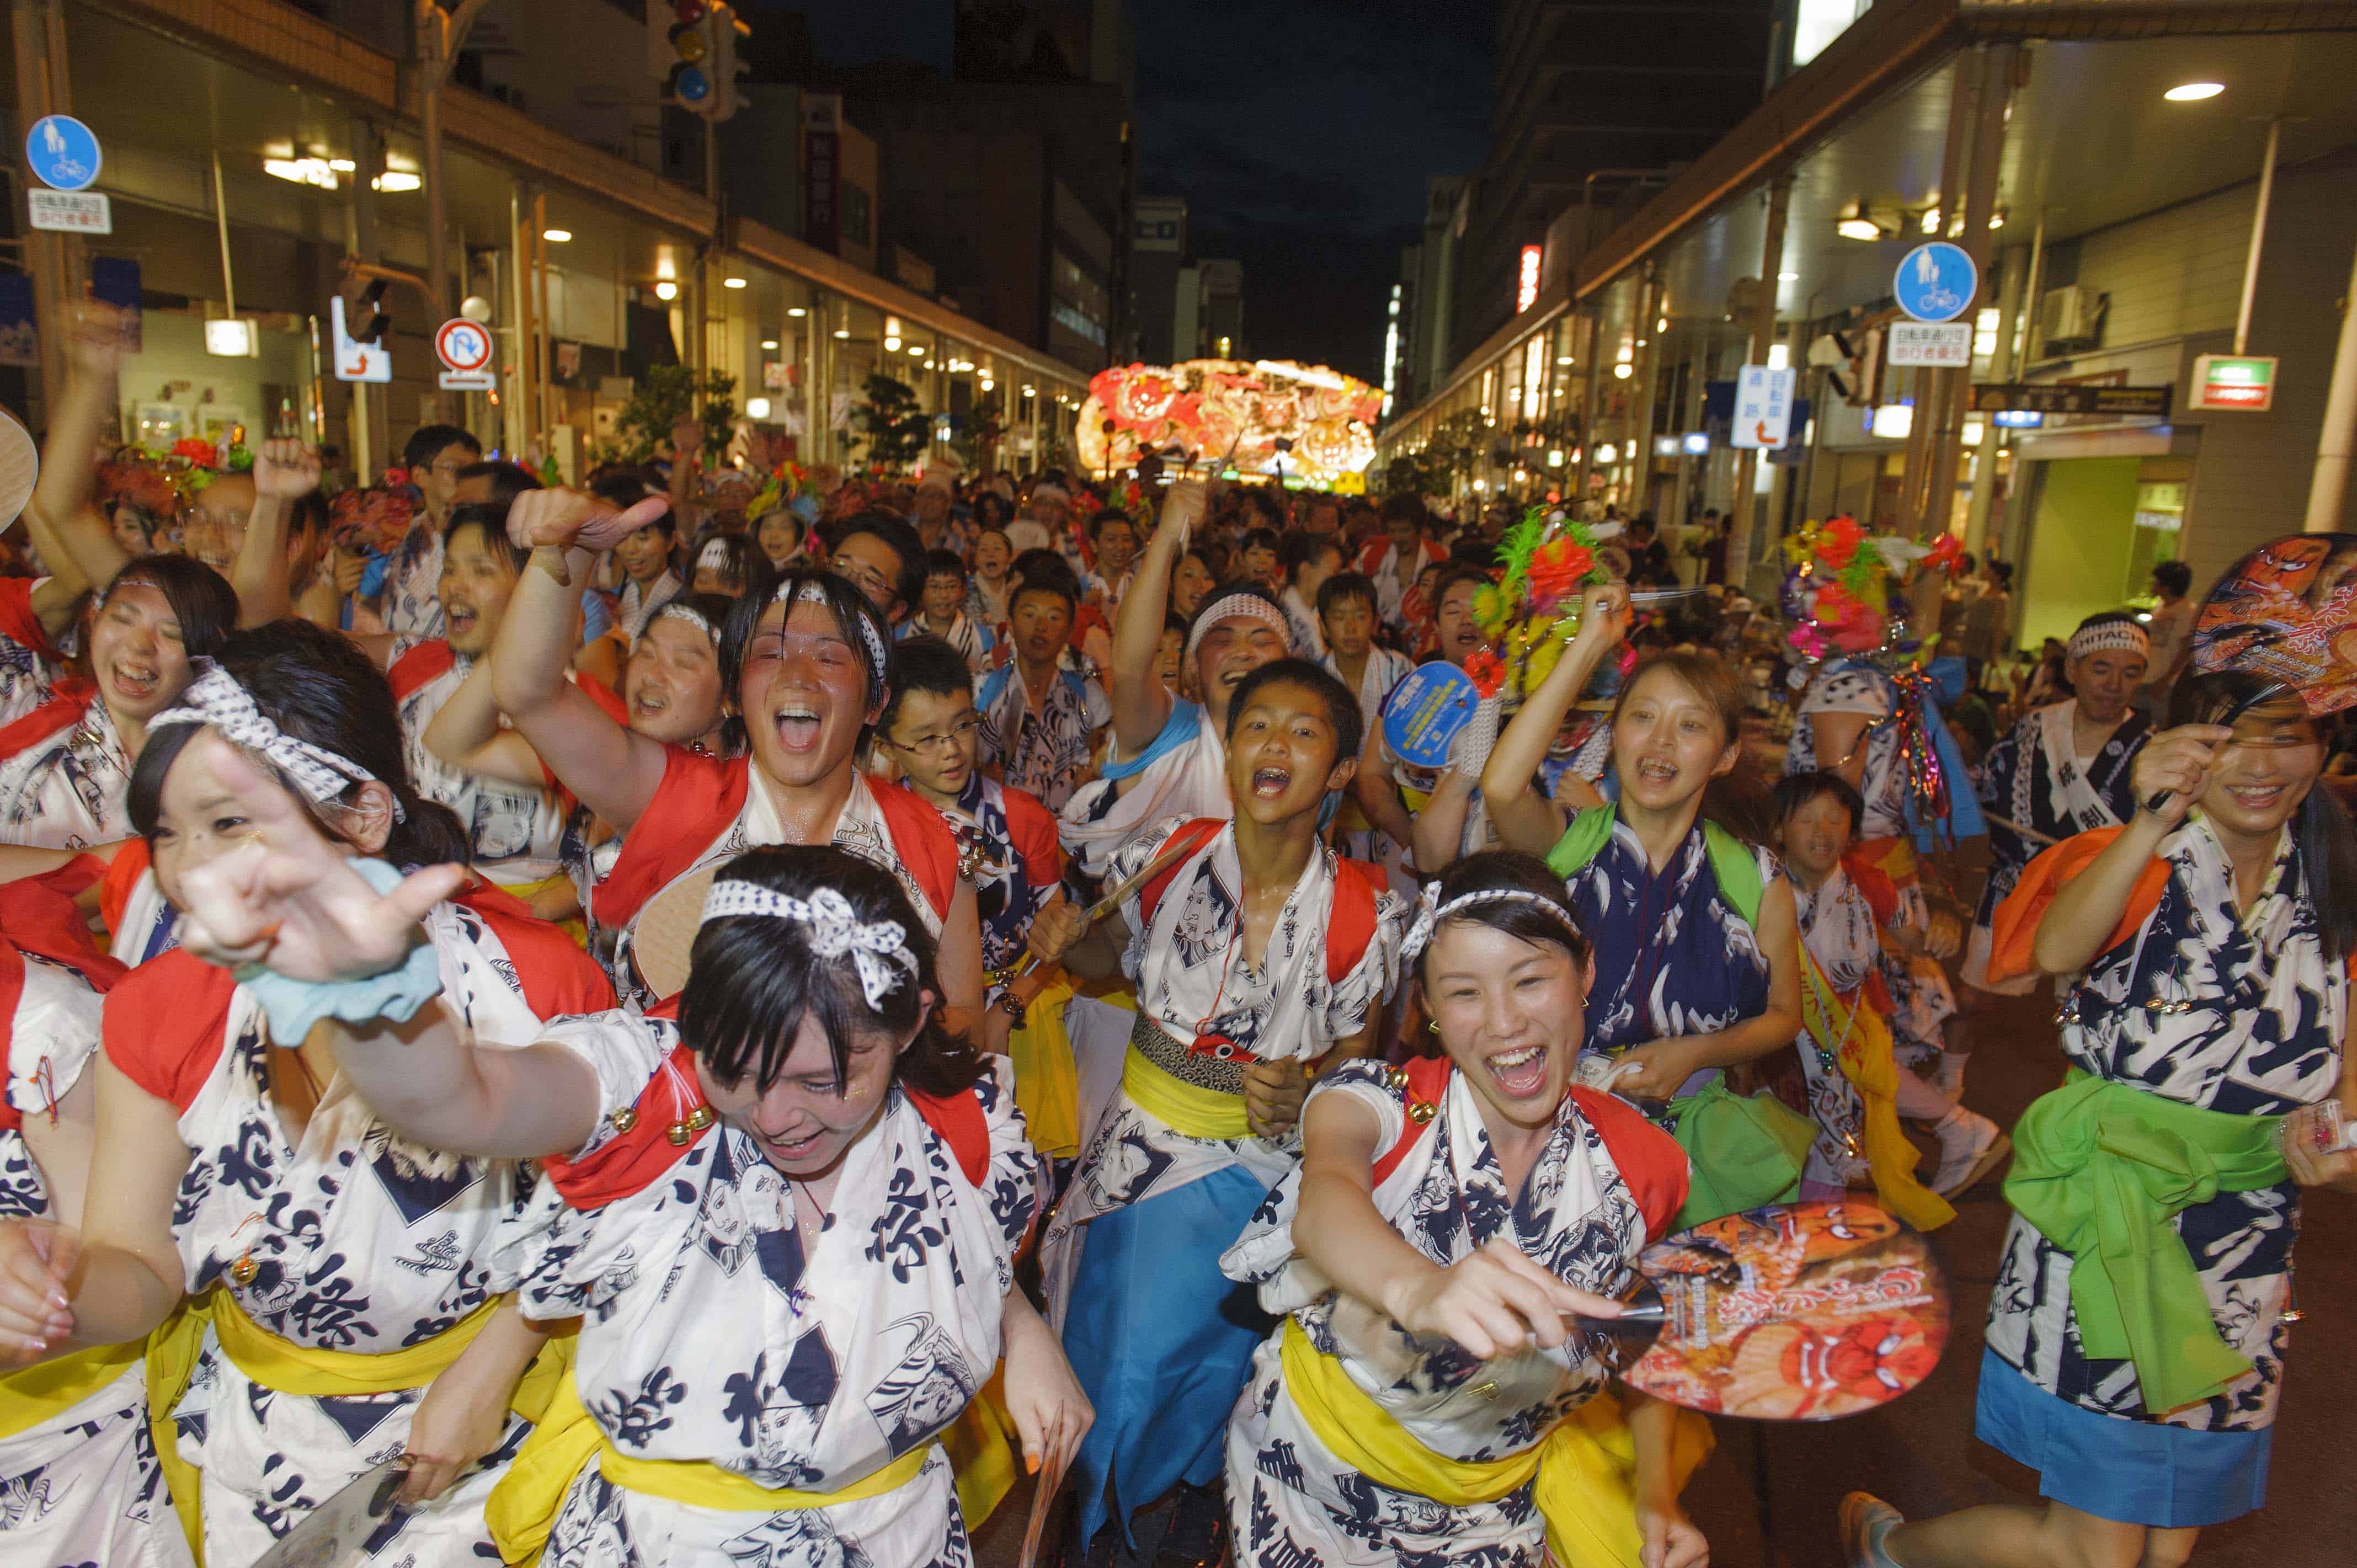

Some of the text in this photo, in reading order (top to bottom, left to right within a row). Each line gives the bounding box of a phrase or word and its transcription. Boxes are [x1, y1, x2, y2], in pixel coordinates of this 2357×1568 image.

[1897, 327, 1965, 342] 自転車通行可
[1896, 345, 1961, 359] 歩行者優先
